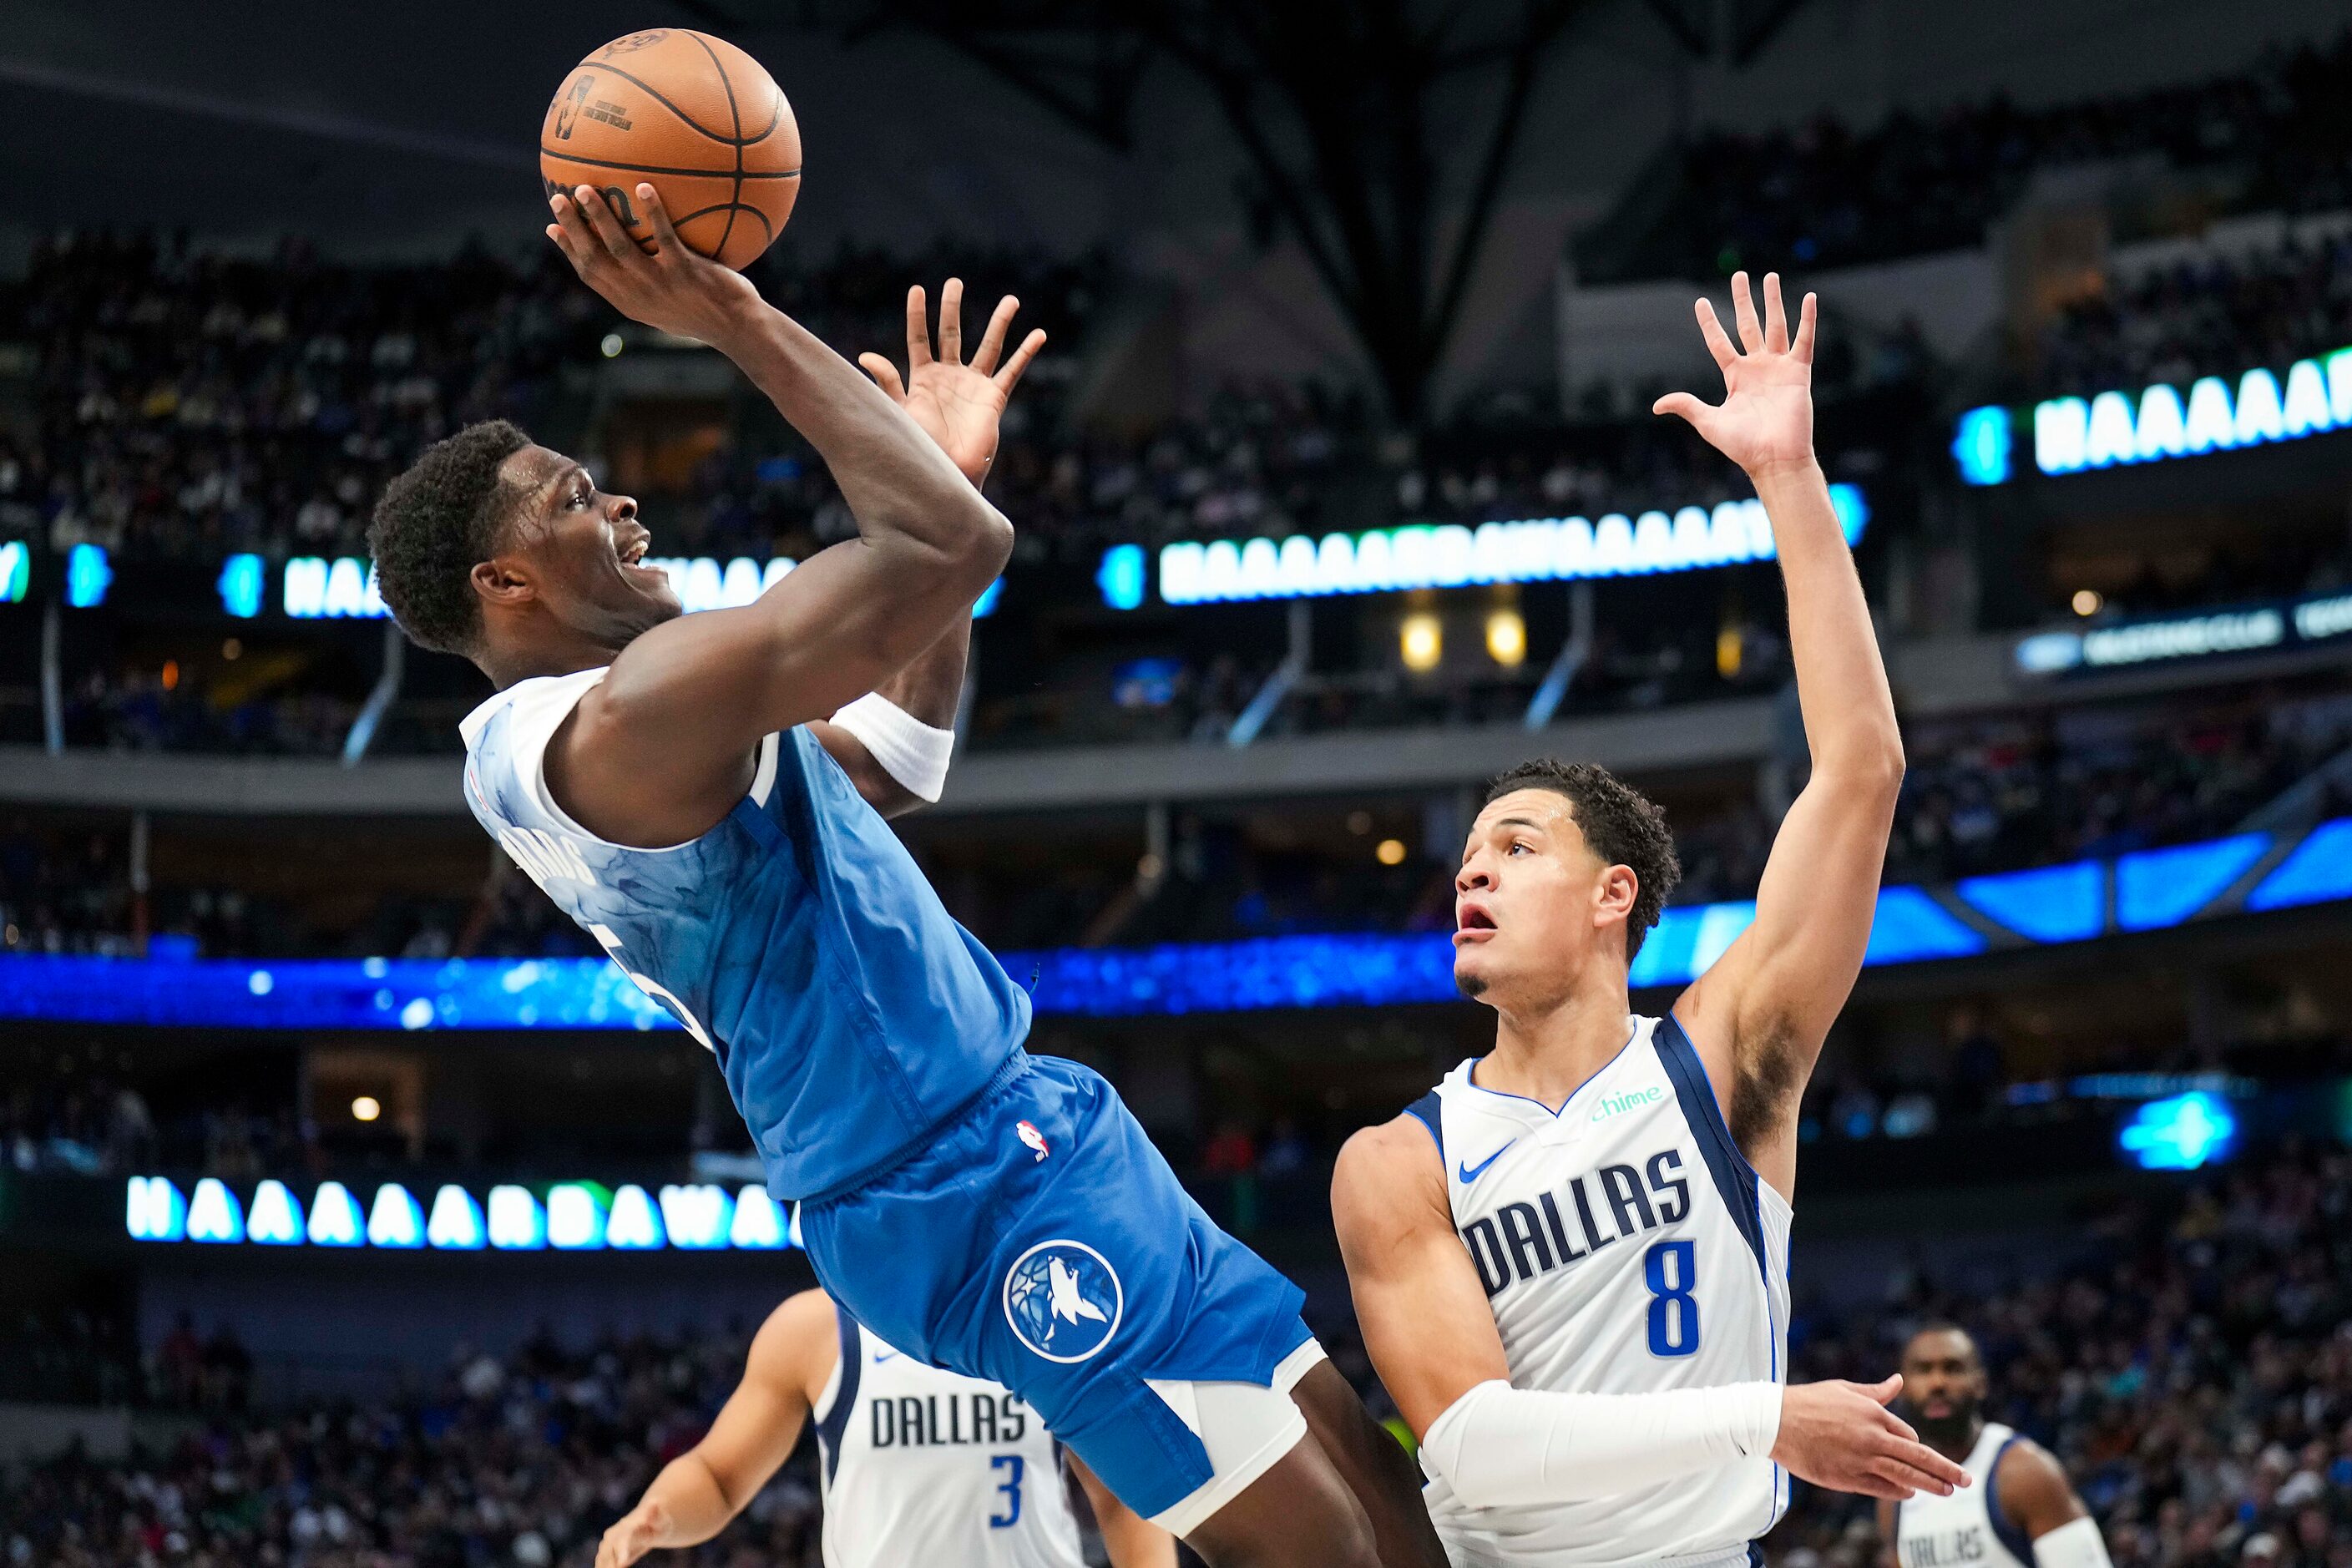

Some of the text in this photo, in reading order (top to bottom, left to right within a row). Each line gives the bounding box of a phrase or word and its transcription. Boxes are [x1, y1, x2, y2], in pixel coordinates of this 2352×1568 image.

[1591, 1085, 1664, 1122] chime
[1461, 1149, 1690, 1297] DALLAS
[1643, 1239, 1701, 1358] 8
[871, 1393, 1026, 1448] DALLAS
[989, 1454, 1024, 1529] 3
